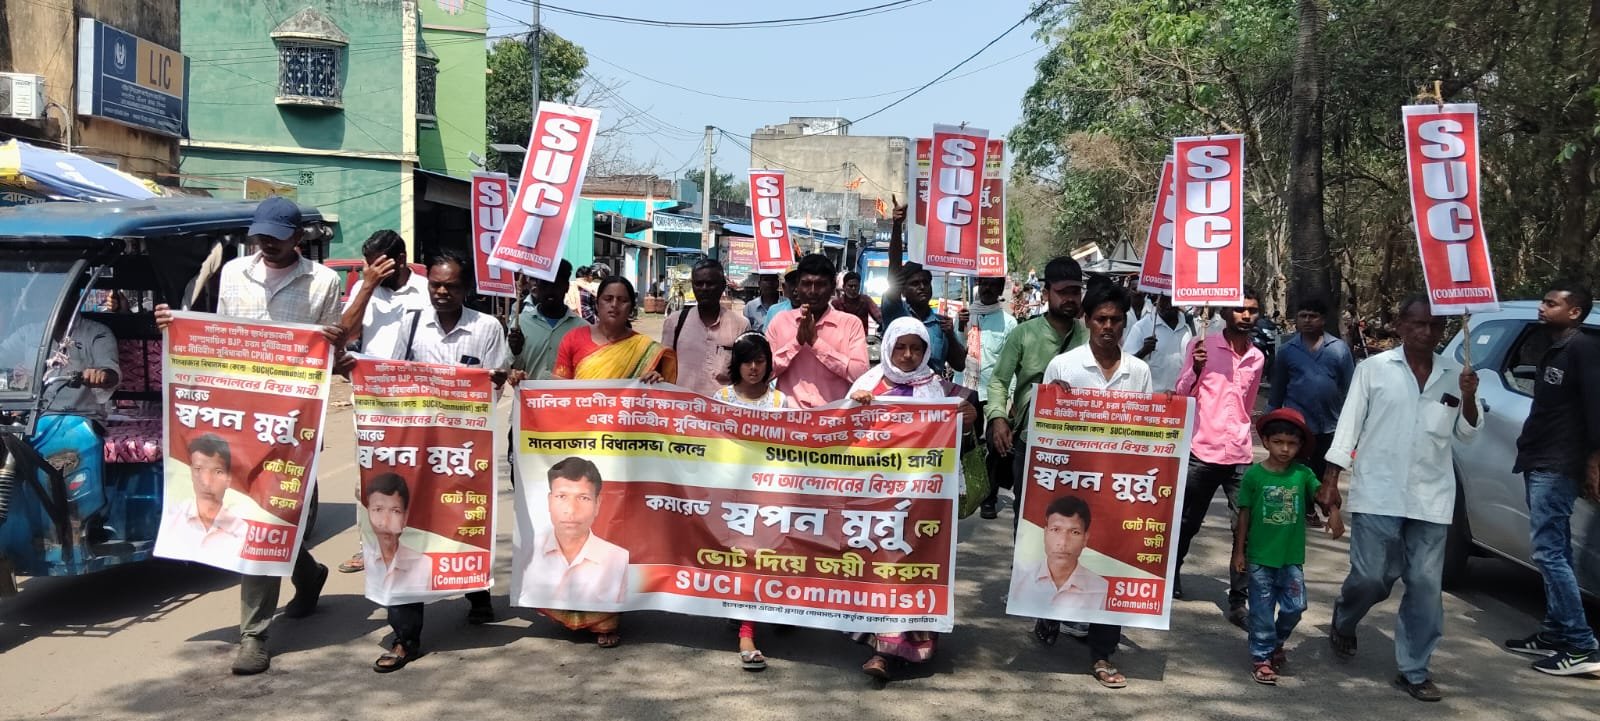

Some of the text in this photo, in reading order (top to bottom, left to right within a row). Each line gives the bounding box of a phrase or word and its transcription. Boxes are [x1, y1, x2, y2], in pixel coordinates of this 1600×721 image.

[149, 49, 171, 89] LIC
[517, 118, 581, 249] SUCI
[936, 138, 976, 254] SUCI
[1418, 119, 1475, 282] SUCI
[755, 176, 784, 259] SUCI
[1185, 145, 1232, 283] SUCI
[498, 246, 551, 268] (COMMUNIST)
[927, 255, 976, 267] (COMMUNIST)
[977, 254, 1000, 266] UCI
[1177, 287, 1238, 298] (COMMUNIST)
[1433, 287, 1493, 300] (COMMUNIST)
[251, 349, 274, 361] CPI(M)
[276, 354, 285, 362] কে
[294, 344, 308, 353] TMC
[252, 364, 306, 380] SUCI(Communist)
[175, 372, 319, 397] গণ আন্দোলনের বিশ্বস্ত সাথী
[175, 387, 210, 401] কমরেড
[526, 394, 571, 409] মালিক
[575, 392, 617, 408] শ্রেণীর
[620, 393, 707, 414] স্বার্থরক্ষাকারী
[818, 415, 846, 427] চরম
[851, 410, 914, 428] দুর্নীতিগ্রস্ত
[919, 409, 951, 423] TMC
[1152, 404, 1166, 412] TMC
[175, 402, 316, 446] স্বপন মুর্মু কে
[370, 414, 432, 425] আন্দোলনের
[465, 417, 487, 428] সাথী
[1111, 412, 1131, 423] CPI(M)
[586, 411, 892, 442] এবং নীতিহীন সুবিধাবাদী CPI(M) কে পরাস্ত করতে
[1110, 427, 1164, 439] SUCI(Communist)
[358, 429, 385, 441] মরেড
[528, 434, 944, 471] মানবাজার বিধানসভা কেন্দ্রে SUCI(Communist) প্রার্থী
[1038, 436, 1176, 454] গণ আন্দোলনের বিশ্বস্ত সাথী
[426, 441, 475, 477] মুর্মু
[474, 459, 489, 472] কে
[1035, 450, 1070, 465] কমরেড
[263, 458, 305, 478] ভোট দিয়ে
[280, 478, 301, 493] জয়ী
[751, 472, 944, 495] গণ আন্দোলনের বিশ্বস্ত সাথী
[1033, 466, 1172, 505] স্বপন মুর্মু কে
[269, 495, 297, 509] করুন
[440, 490, 487, 506] ভোট দিয়ে
[464, 506, 487, 521] জয়ী
[457, 526, 486, 536] করুন
[645, 494, 940, 555] কমরেড স্বপন মুর্মু কে
[1122, 517, 1167, 533] ভোট দিয়ে
[249, 526, 288, 545] SUCI
[1144, 536, 1164, 549] জয়ী
[439, 555, 482, 572] SUCI
[697, 546, 940, 581] ভোট দিয়ে জয়ী করুন
[1137, 553, 1162, 564] করুন
[434, 573, 487, 587] (Communist)
[675, 570, 936, 612] SUCI (Communist)
[1115, 581, 1157, 598] SUCI
[1108, 597, 1160, 612] (Communist)
